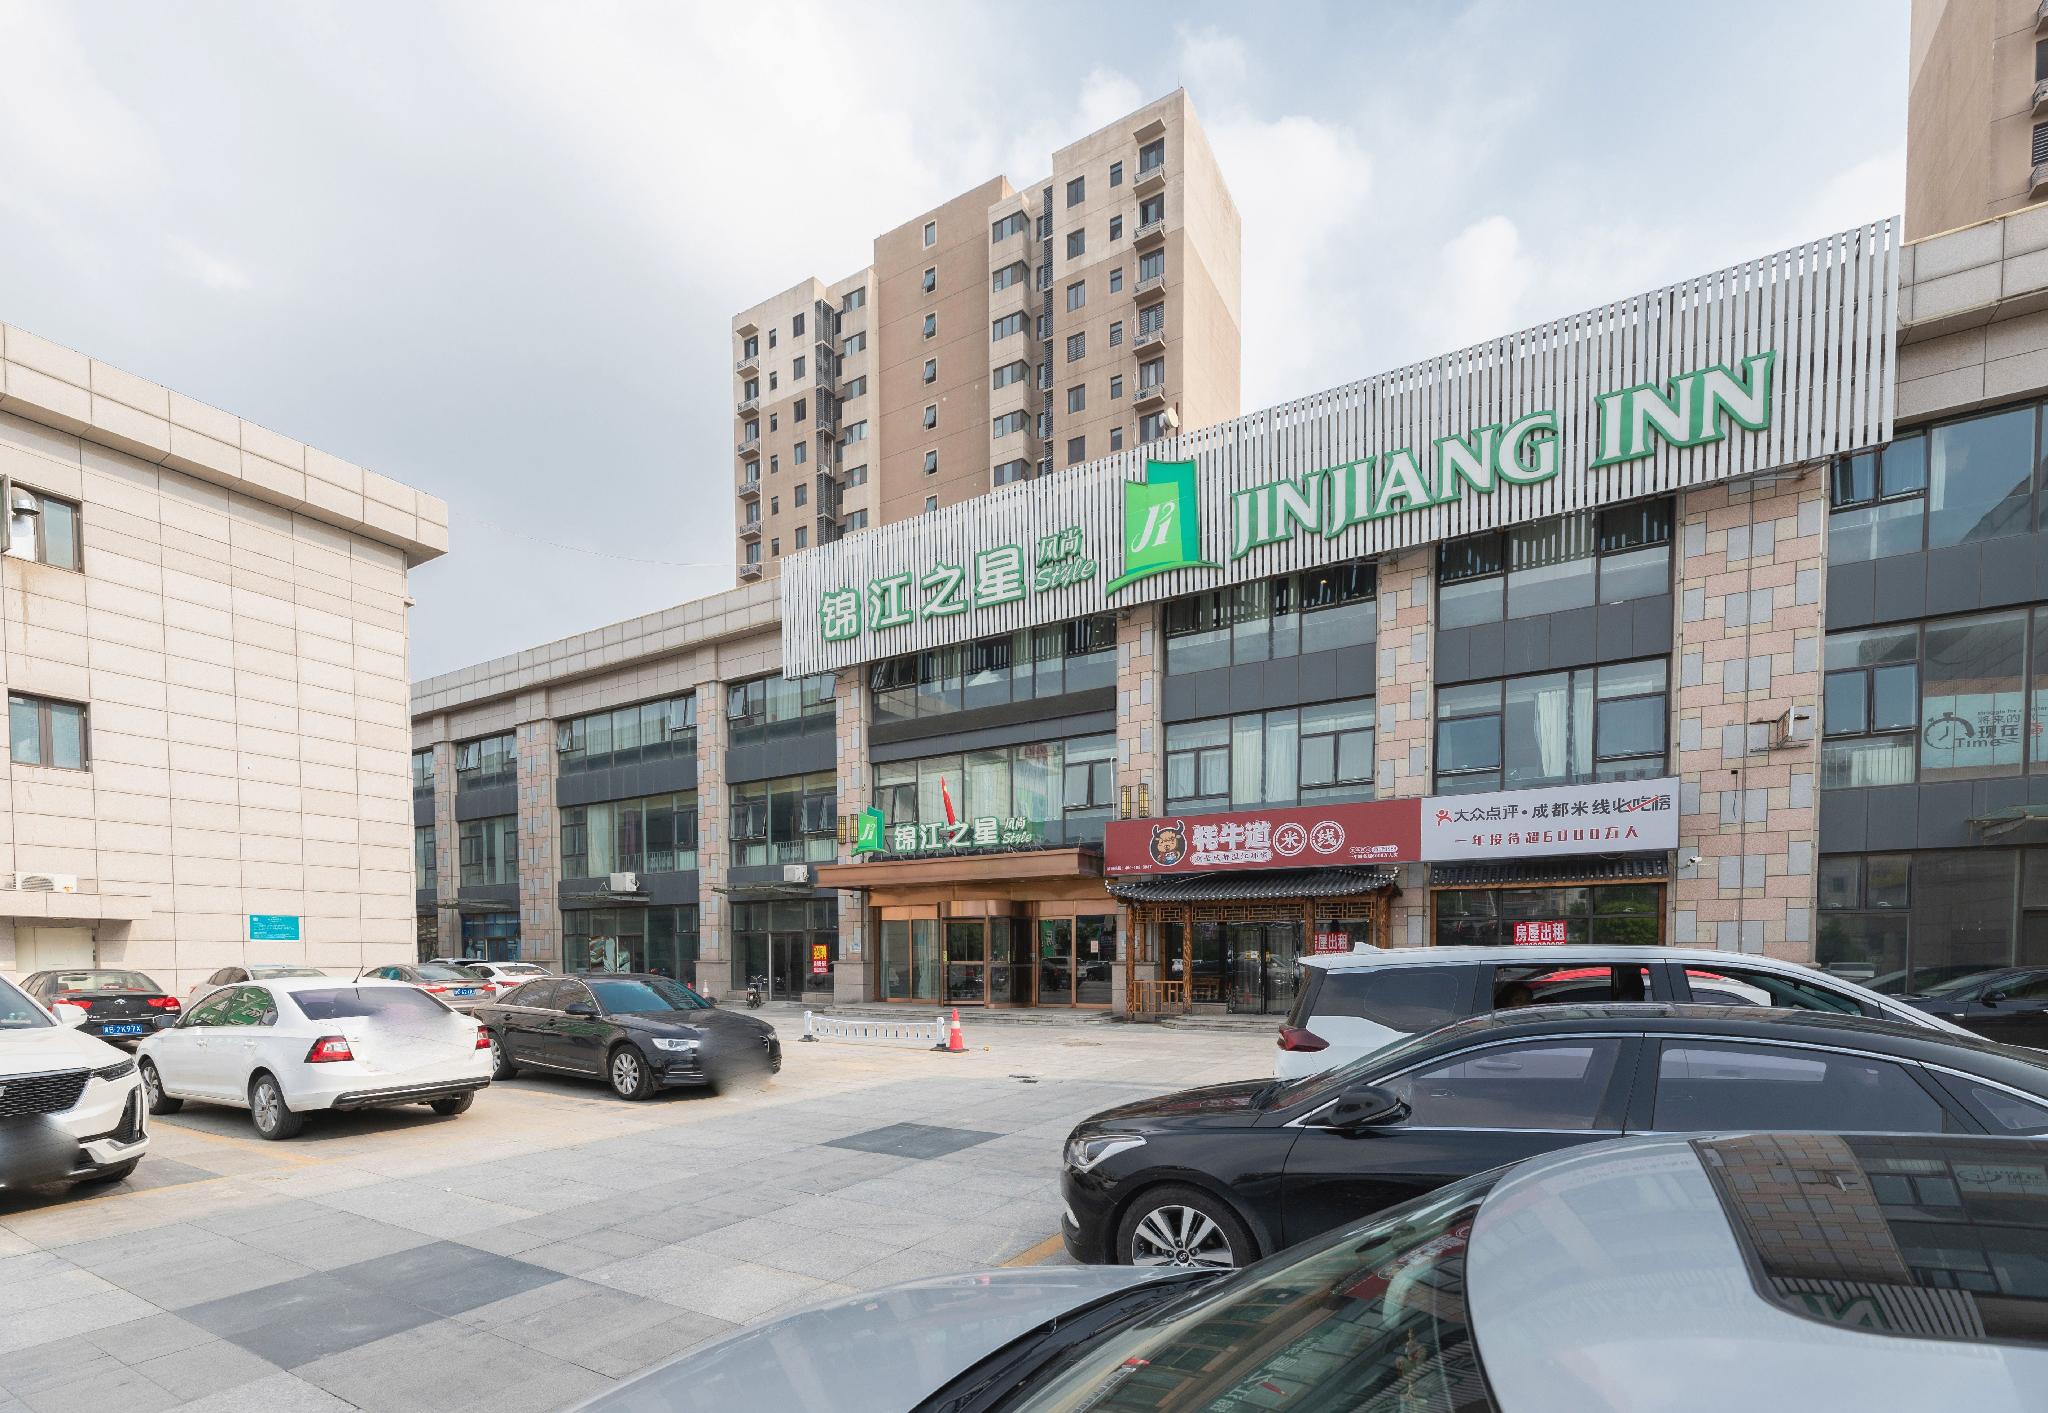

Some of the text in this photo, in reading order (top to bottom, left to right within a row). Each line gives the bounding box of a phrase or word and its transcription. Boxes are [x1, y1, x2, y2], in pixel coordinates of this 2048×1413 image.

[1230, 350, 1776, 561] JINJIANG INN
[1036, 524, 1083, 567] 风尚
[1034, 554, 1097, 593] Style
[819, 543, 1026, 642] 锦江之星
[1955, 738, 2000, 748] Time
[894, 816, 999, 851] 锦江之星
[1002, 831, 1032, 844] Style
[1004, 817, 1027, 831] 风尚
[1516, 923, 1564, 942] 房屋出租
